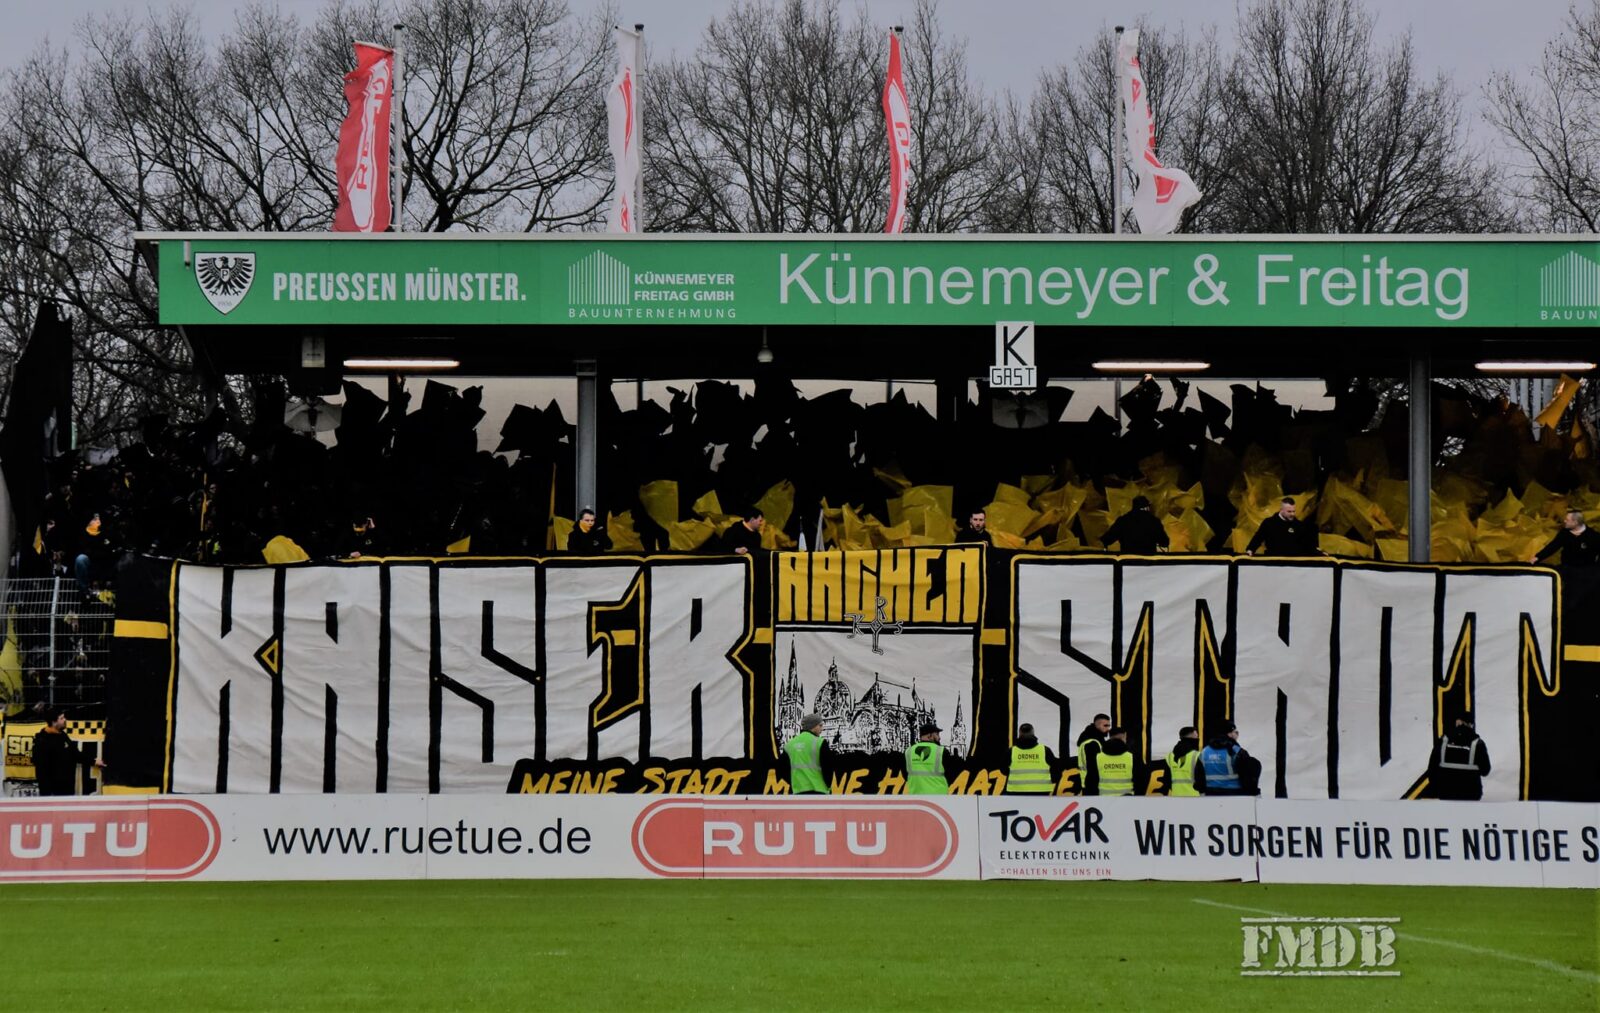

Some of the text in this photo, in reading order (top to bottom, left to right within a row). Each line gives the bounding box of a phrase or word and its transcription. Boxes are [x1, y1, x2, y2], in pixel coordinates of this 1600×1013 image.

[273, 267, 527, 301] PREUSSEN MÜNSTER.
[634, 271, 735, 285] KÜNNEMEYER
[634, 290, 735, 301] FREITAG GMBH
[779, 253, 1469, 320] Künnemeyer & Freitag
[568, 308, 736, 319] BAUUNTERNEHMUNG
[1003, 326, 1029, 366] K
[991, 367, 1035, 387] GAST
[778, 549, 981, 623] AACHEN
[173, 562, 747, 794] KAISER
[1014, 562, 1555, 800] STADT
[263, 817, 592, 854] www.ruetue.de
[703, 821, 887, 856] RÜTÜ
[1208, 823, 1323, 859] SORGEN
[1336, 821, 1393, 860] FÜR
[1403, 827, 1450, 860] DIE
[1462, 823, 1570, 862] NÖTIGE
[1000, 850, 1110, 860] ELEKTROTECHNIK
[1001, 867, 1111, 877] SCHALTEN SIE UNS EIN
